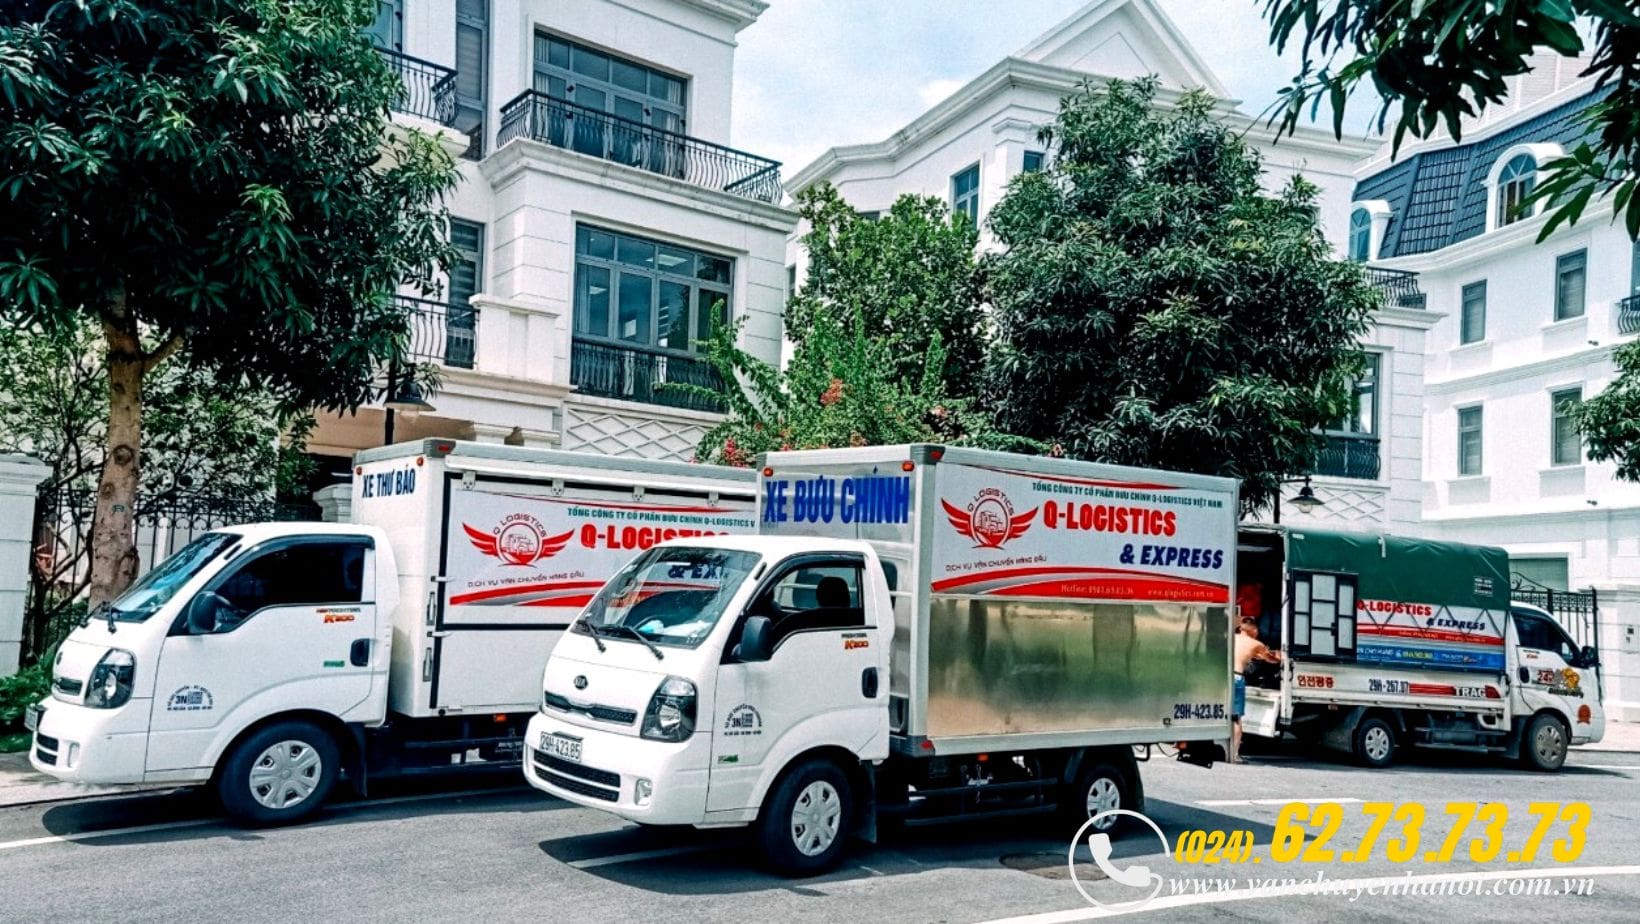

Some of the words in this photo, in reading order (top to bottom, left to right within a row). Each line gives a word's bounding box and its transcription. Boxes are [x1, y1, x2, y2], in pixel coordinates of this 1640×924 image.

[362, 474, 374, 498] XE
[377, 469, 395, 496] THƯ
[764, 480, 788, 522] XE
[794, 475, 835, 523] BƯU
[841, 466, 909, 523] CHÍNH
[1053, 484, 1073, 494] CÔNG
[1075, 486, 1084, 495] TY
[592, 508, 614, 519] CÔNG
[617, 511, 625, 519] TY
[1043, 499, 1176, 537] Q-LOGISTICS
[1120, 544, 1134, 564] &
[1141, 545, 1223, 569] EXPRESS
[1437, 618, 1486, 631] EXPRESS
